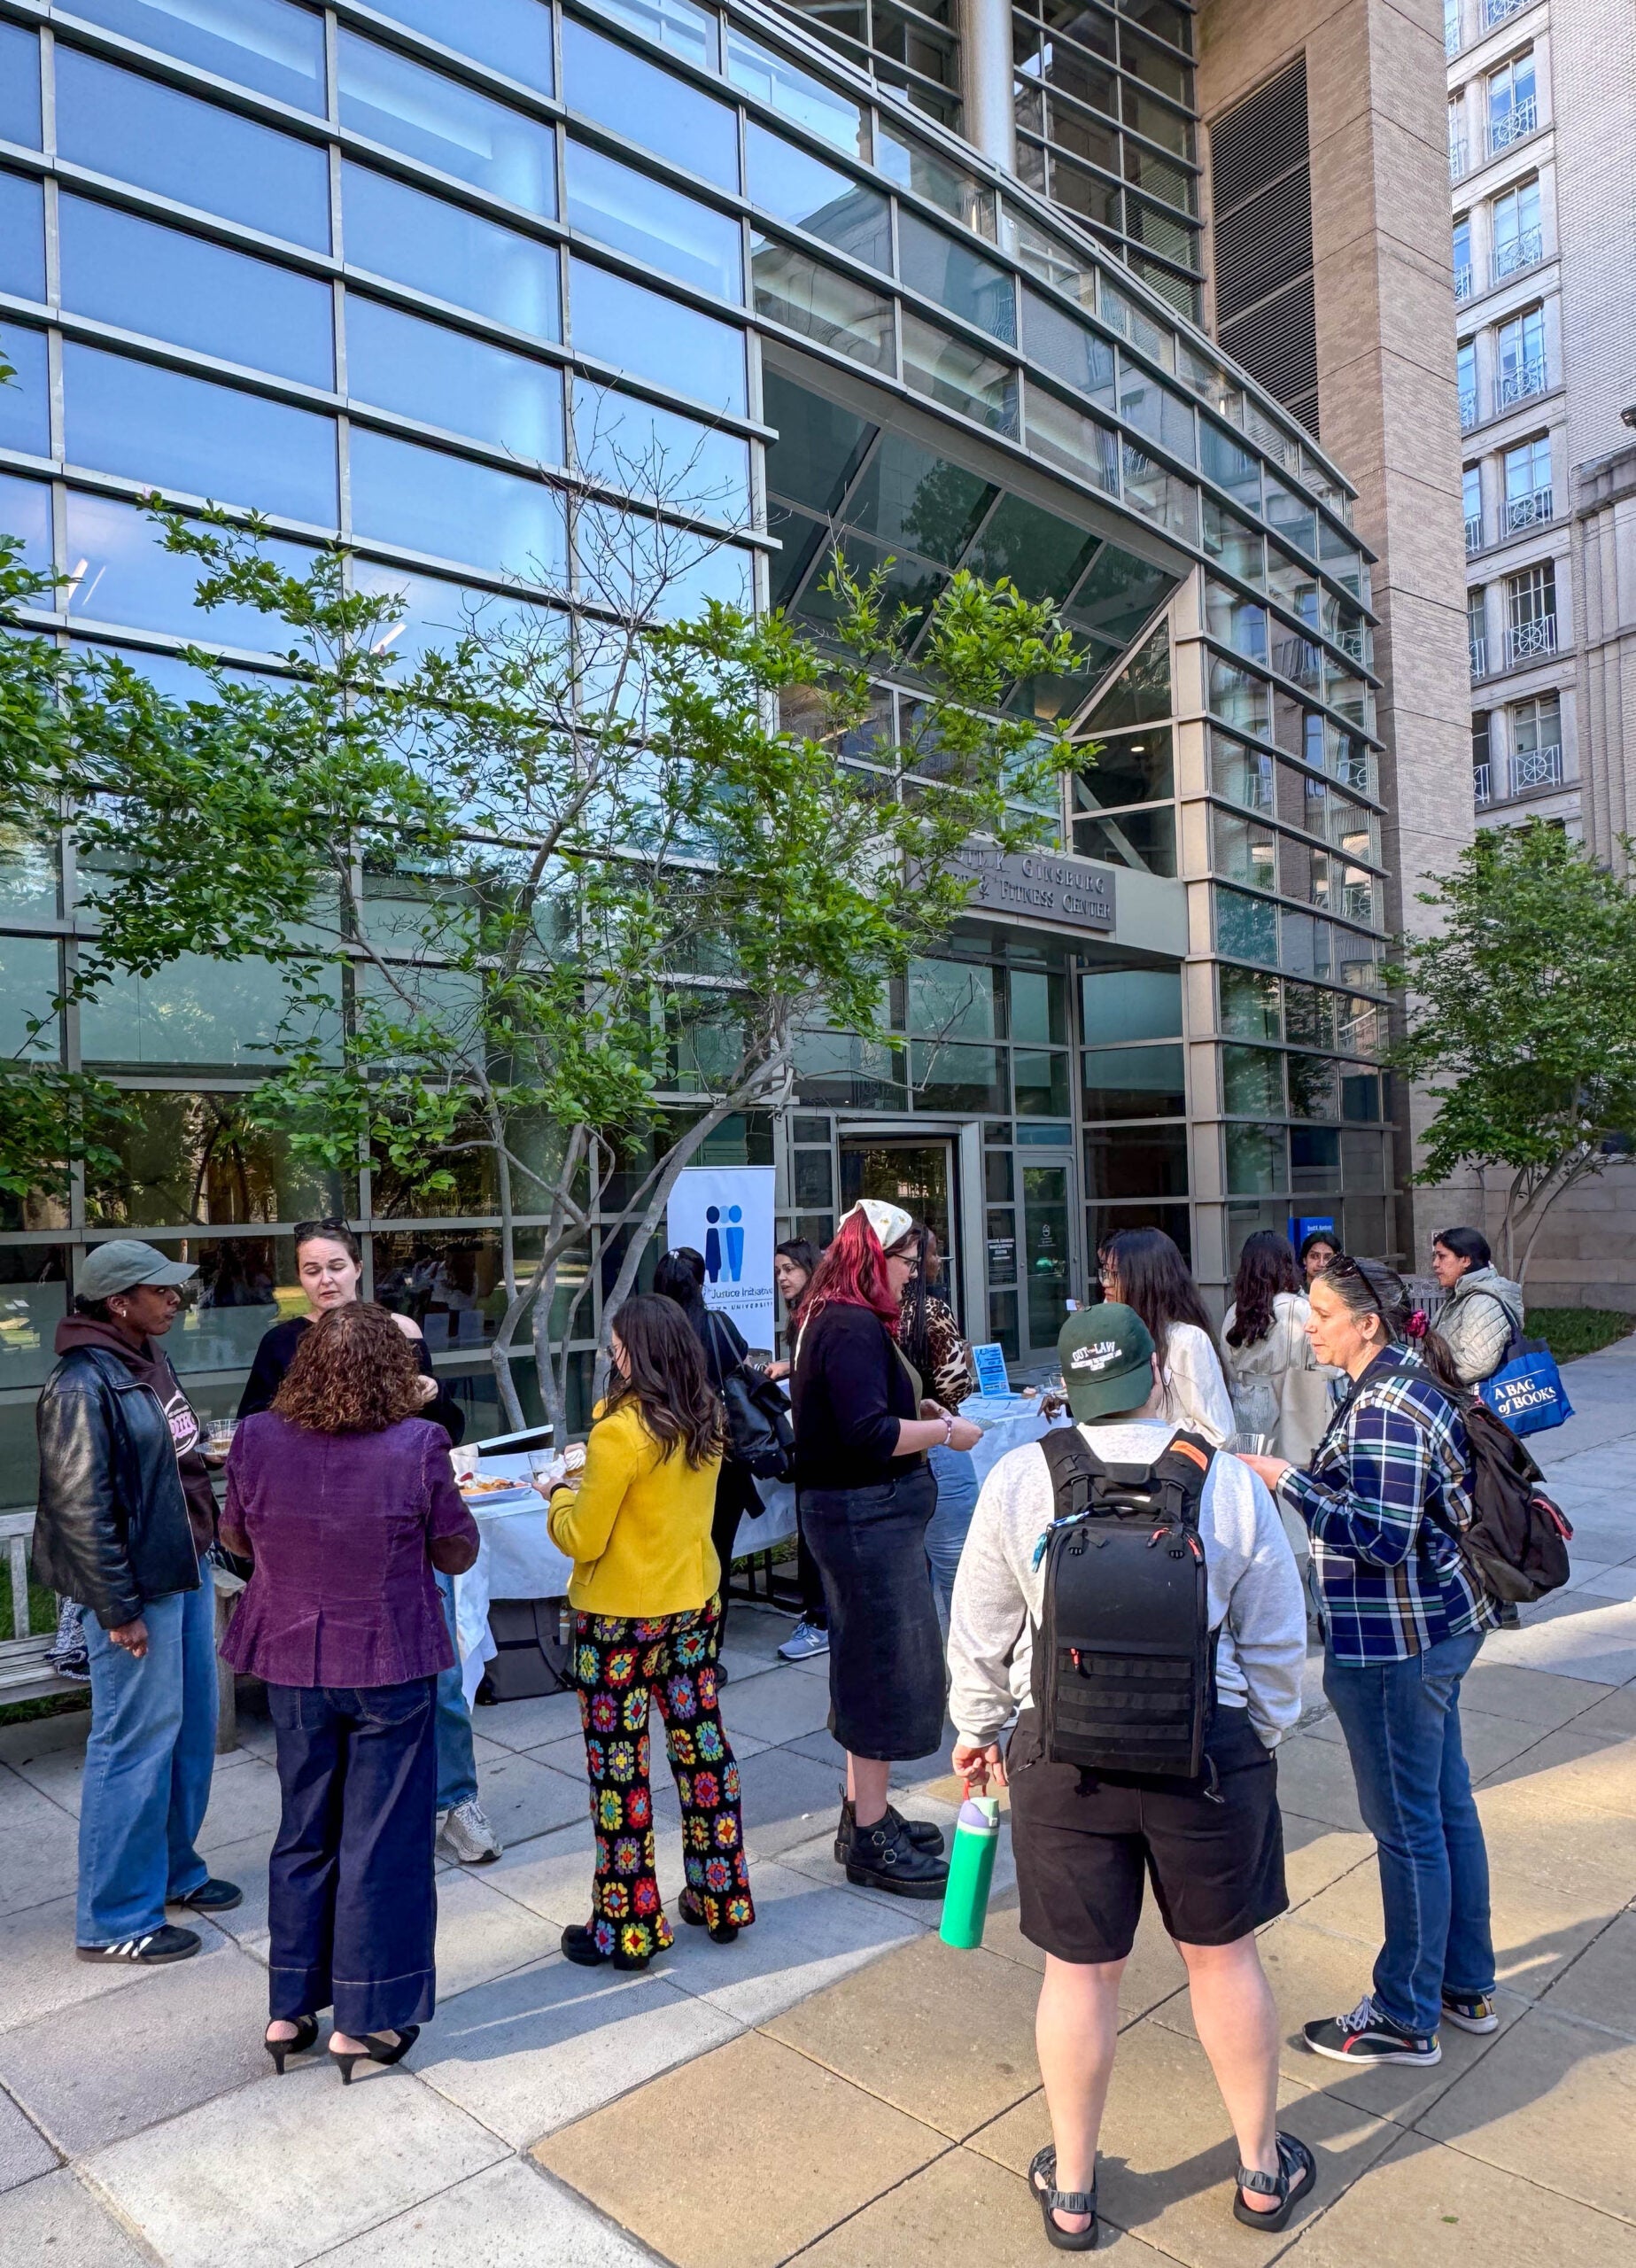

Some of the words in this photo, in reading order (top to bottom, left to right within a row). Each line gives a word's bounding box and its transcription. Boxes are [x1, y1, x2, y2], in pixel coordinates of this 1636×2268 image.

[1494, 1388, 1506, 1400] A
[1506, 1379, 1535, 1396] BAG
[1498, 1399, 1511, 1414] of
[1512, 1386, 1556, 1409] BOOKS
